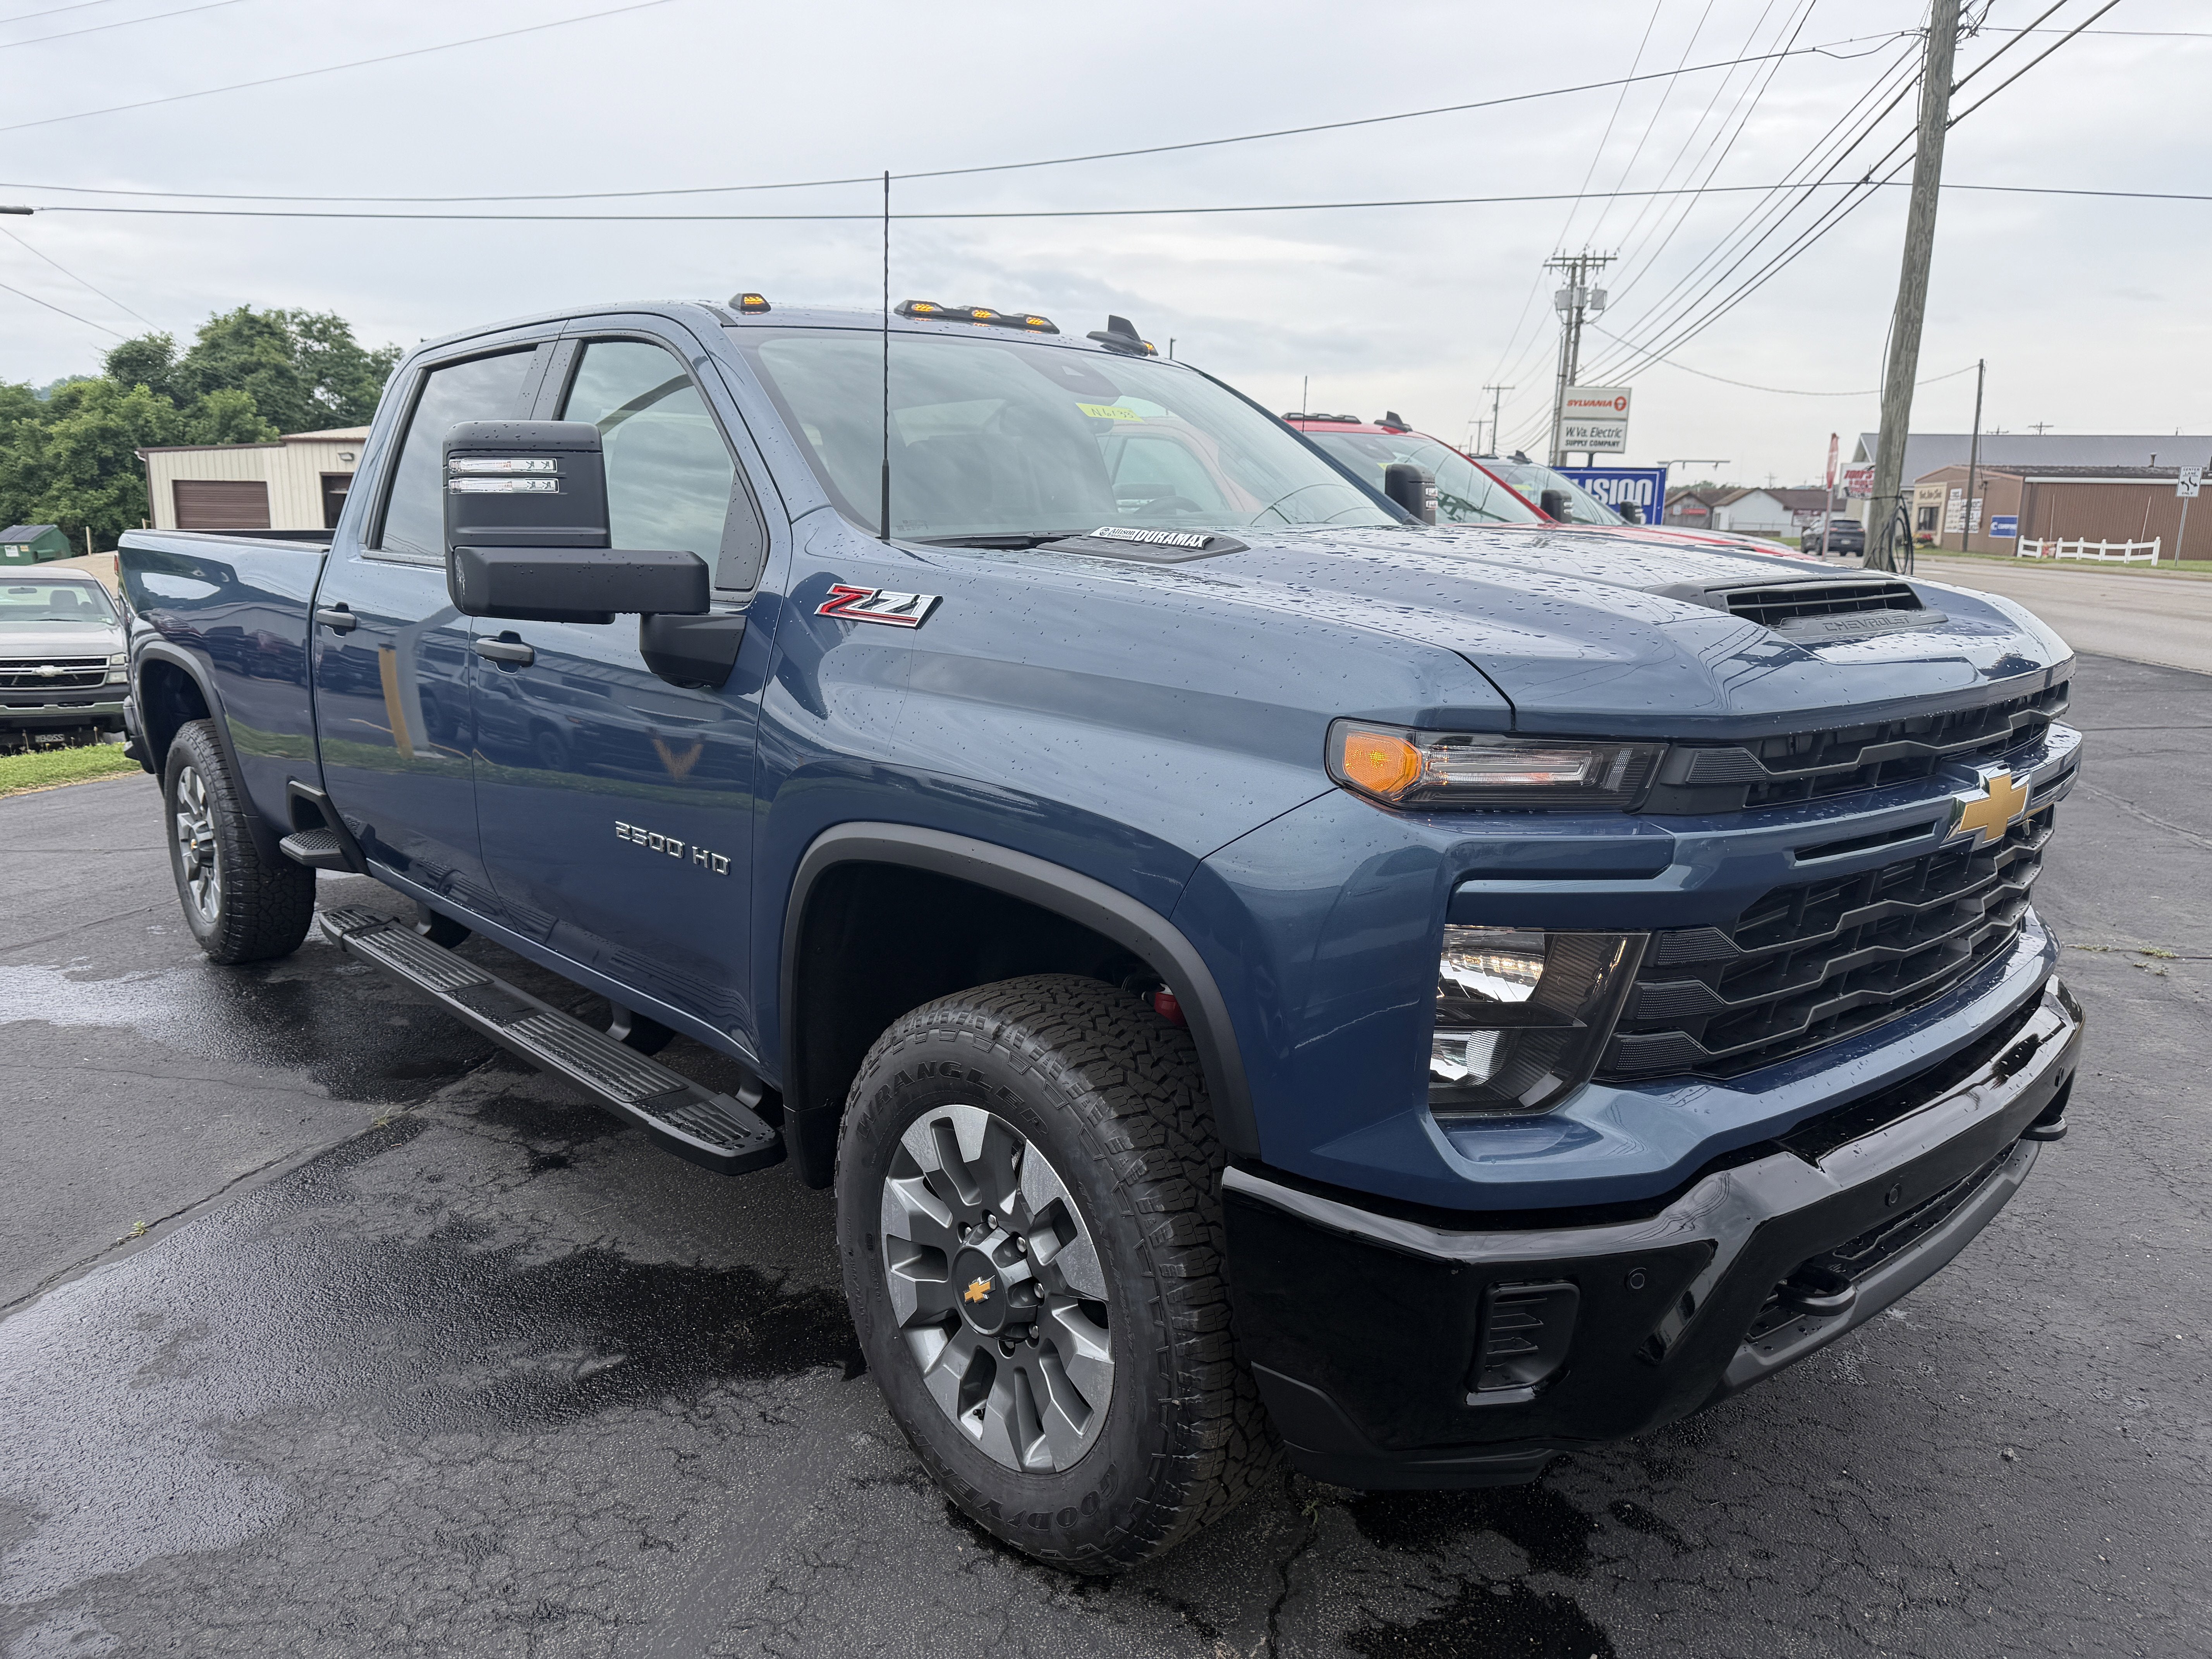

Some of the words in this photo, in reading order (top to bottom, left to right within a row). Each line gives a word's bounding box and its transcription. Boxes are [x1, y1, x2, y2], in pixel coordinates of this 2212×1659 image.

[1589, 427, 1623, 438] Electric
[1134, 530, 1212, 548] DURAMAX
[814, 583, 943, 629] Z71
[1822, 615, 1909, 631] CHEVROLET
[615, 821, 685, 859] 2500
[692, 846, 731, 876] HD
[856, 1060, 1049, 1139] WRANGLER
[904, 1418, 1119, 1531] GOODYEAR
